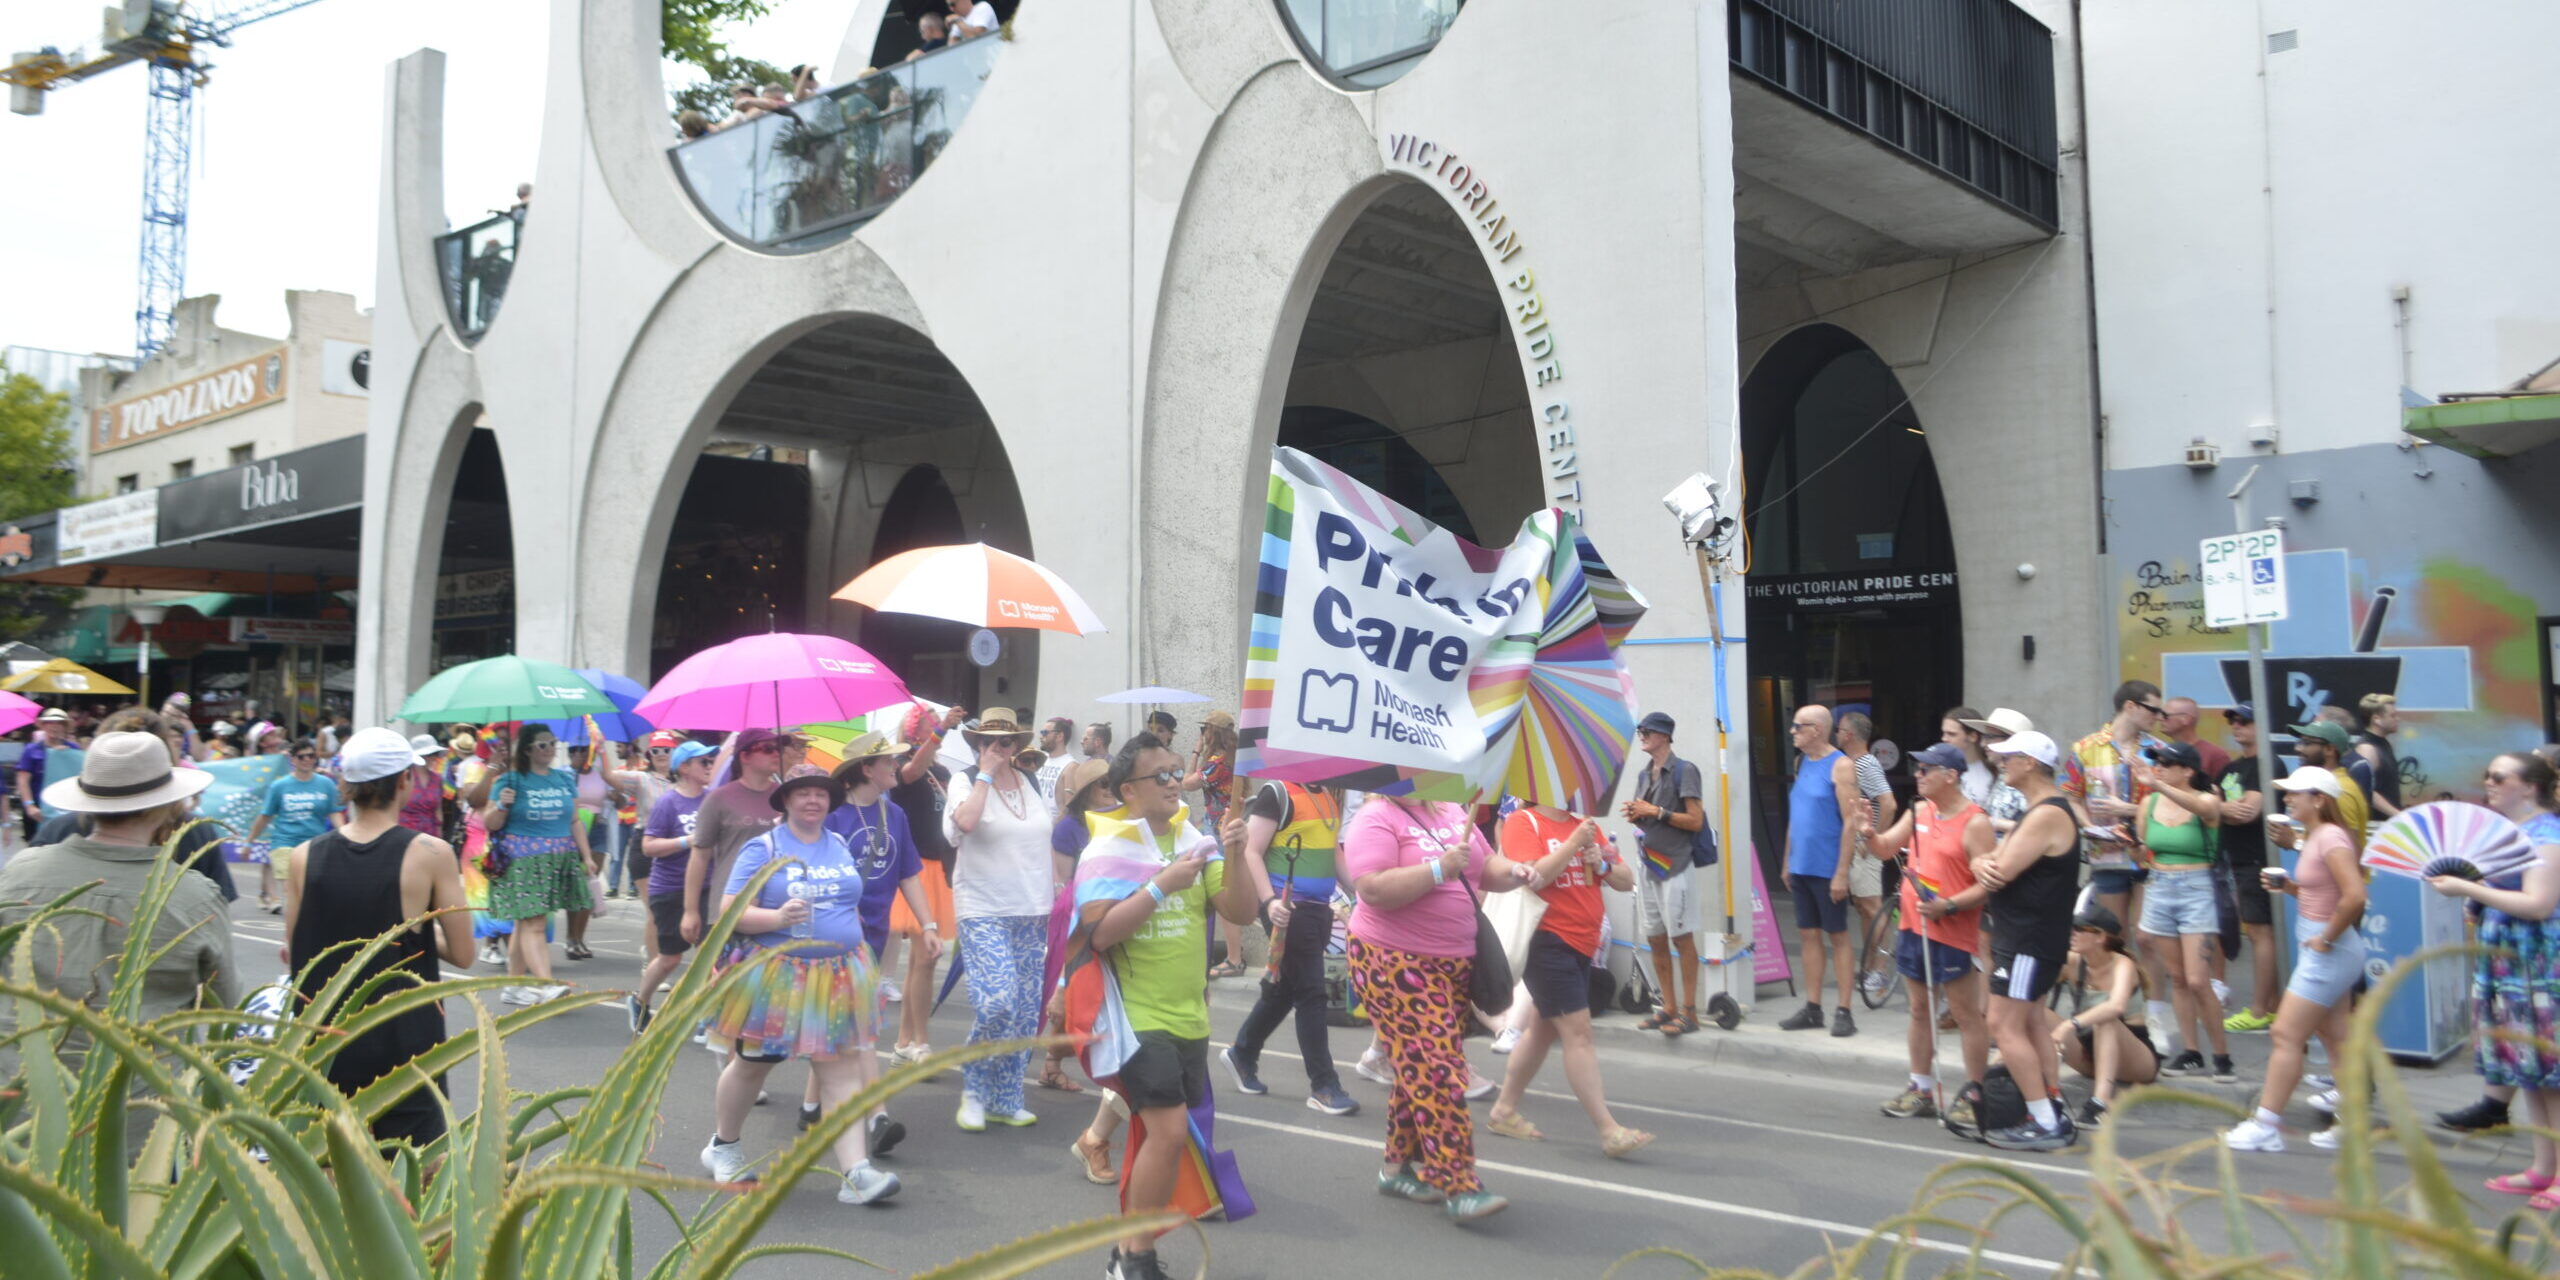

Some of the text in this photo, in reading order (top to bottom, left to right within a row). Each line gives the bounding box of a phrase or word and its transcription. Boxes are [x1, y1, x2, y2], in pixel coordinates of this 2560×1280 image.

[1390, 133, 1522, 263] VICTORIAN
[1508, 267, 1562, 388] PRIDE
[118, 363, 257, 440] TOPOLINOS
[241, 460, 299, 510] Buba
[2205, 540, 2237, 563] 2P
[2246, 534, 2278, 557] 2P
[1747, 571, 1959, 597] THE VICTORIAN PRIDE CEN
[2138, 560, 2191, 588] Bain
[1853, 594, 1875, 603] come
[1876, 592, 1894, 601] with
[1895, 590, 1929, 602] purpose
[1313, 585, 1469, 682] Care
[1374, 679, 1453, 727] Monash
[1370, 710, 1448, 750] Health
[528, 798, 563, 808] Care
[786, 864, 839, 881] Pride
